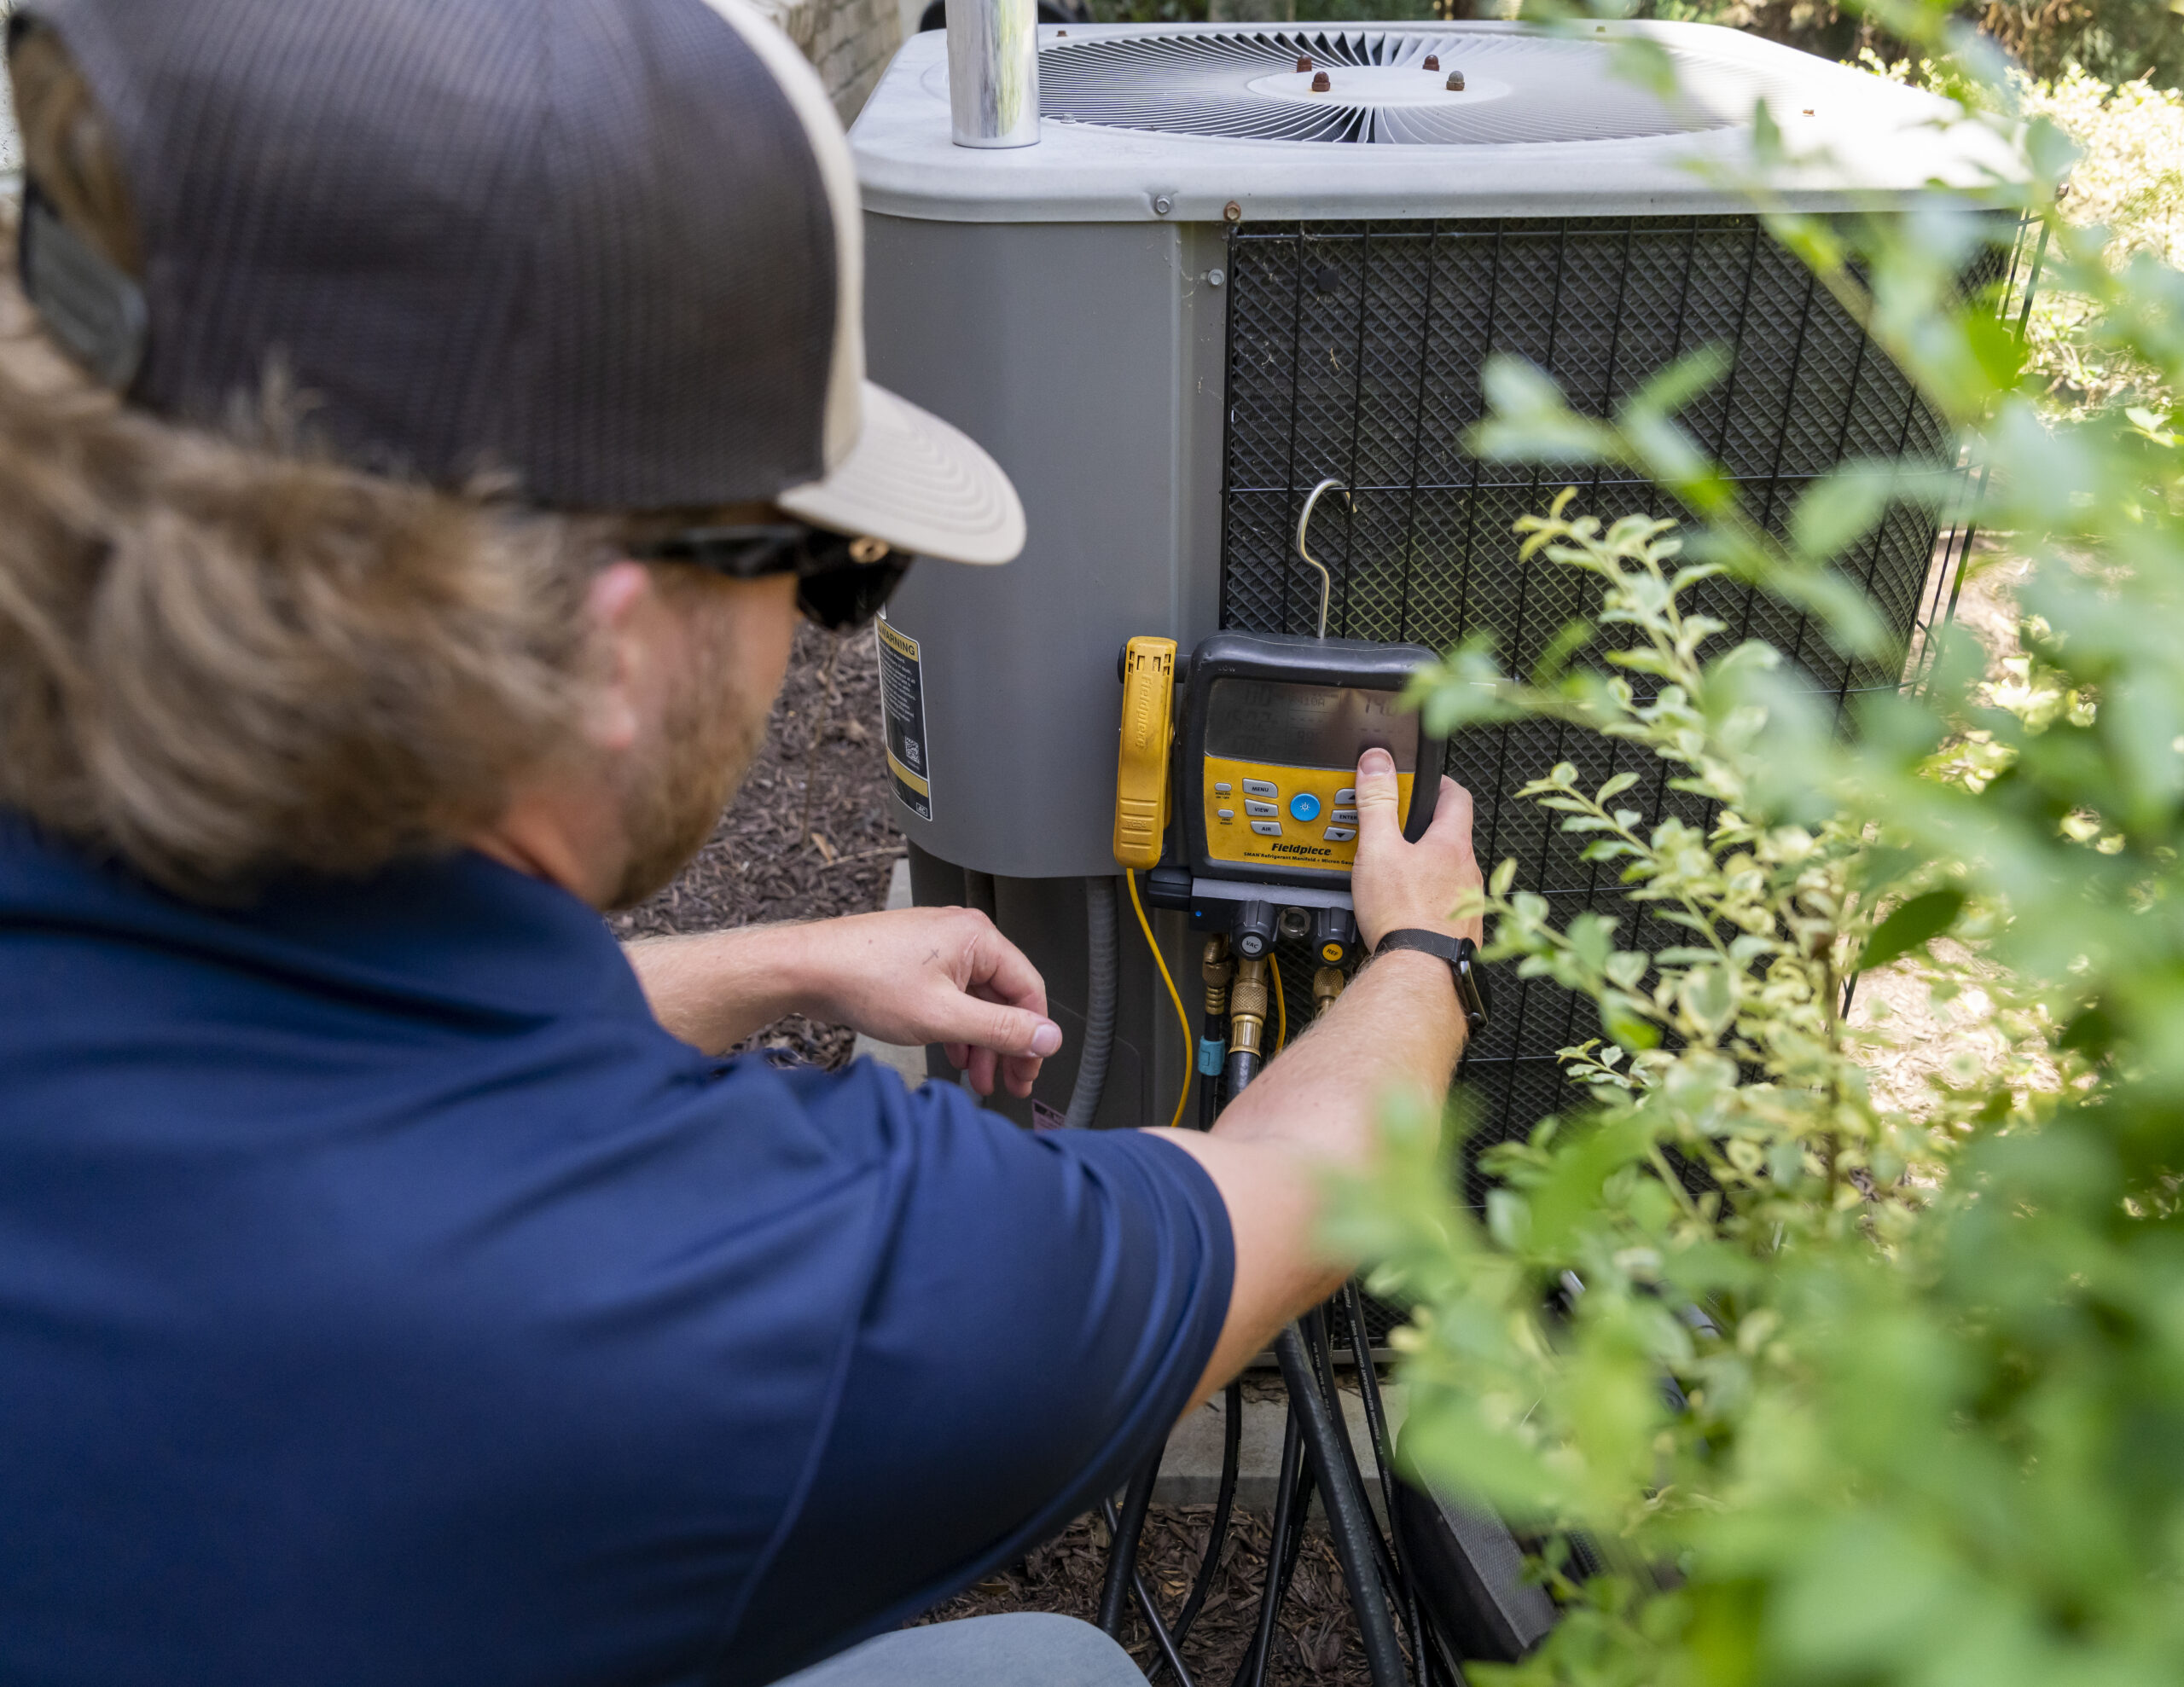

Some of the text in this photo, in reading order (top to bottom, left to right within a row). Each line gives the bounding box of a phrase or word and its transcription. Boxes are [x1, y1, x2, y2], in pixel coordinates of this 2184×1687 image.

[880, 625, 915, 656] WARNING
[1271, 843, 1332, 855] Fieldpiece
[1246, 941, 1259, 949] VAC
[1327, 948, 1339, 956] REF
[1342, 1283, 1352, 1308] Fieldp
[1353, 1336, 1365, 1368] CHARGING
[1360, 1368, 1375, 1411] REFRIGERANT
[1370, 1411, 1381, 1441] PREMIUM
